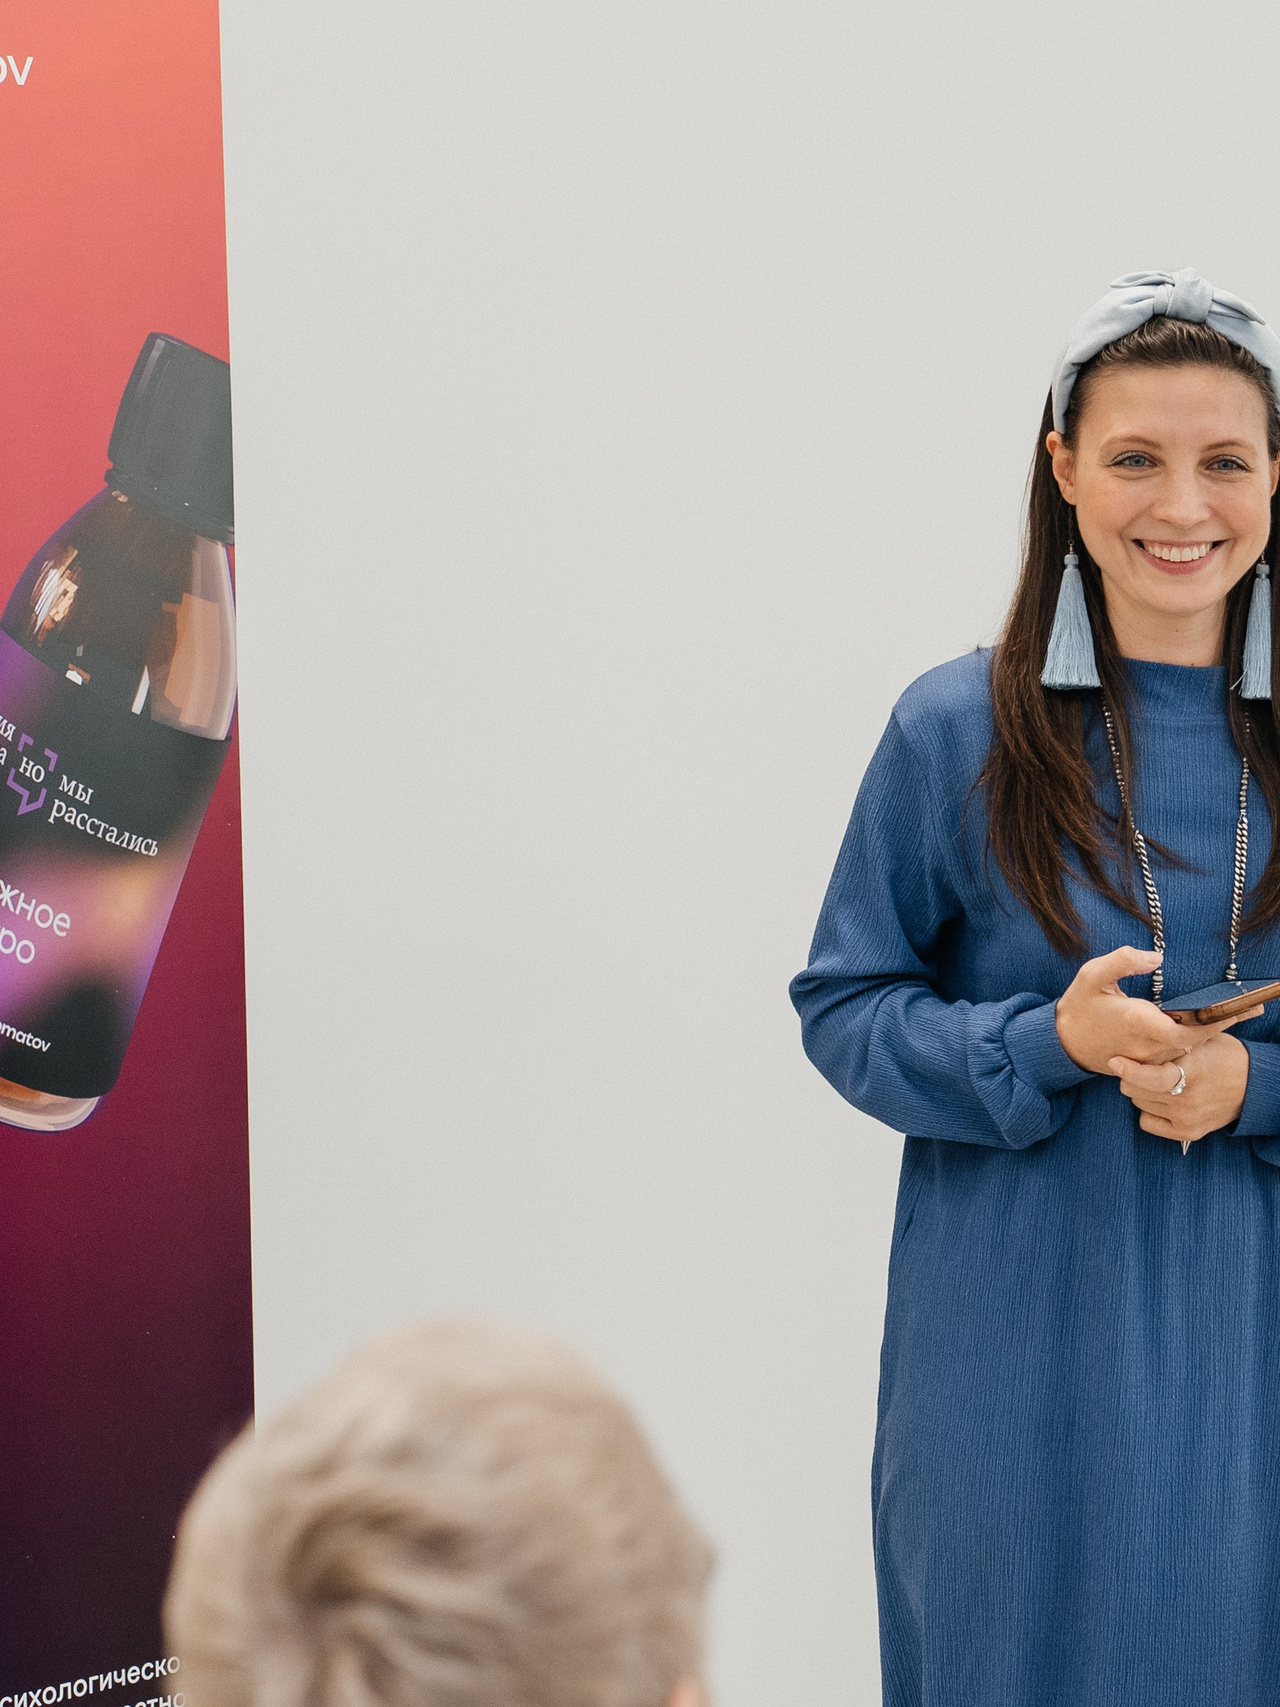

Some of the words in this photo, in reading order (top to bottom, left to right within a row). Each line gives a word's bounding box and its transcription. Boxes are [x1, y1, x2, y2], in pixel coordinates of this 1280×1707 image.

[19, 756, 45, 783] но
[58, 774, 94, 805] мы
[48, 798, 159, 857] расстались
[0, 1021, 51, 1052] matov
